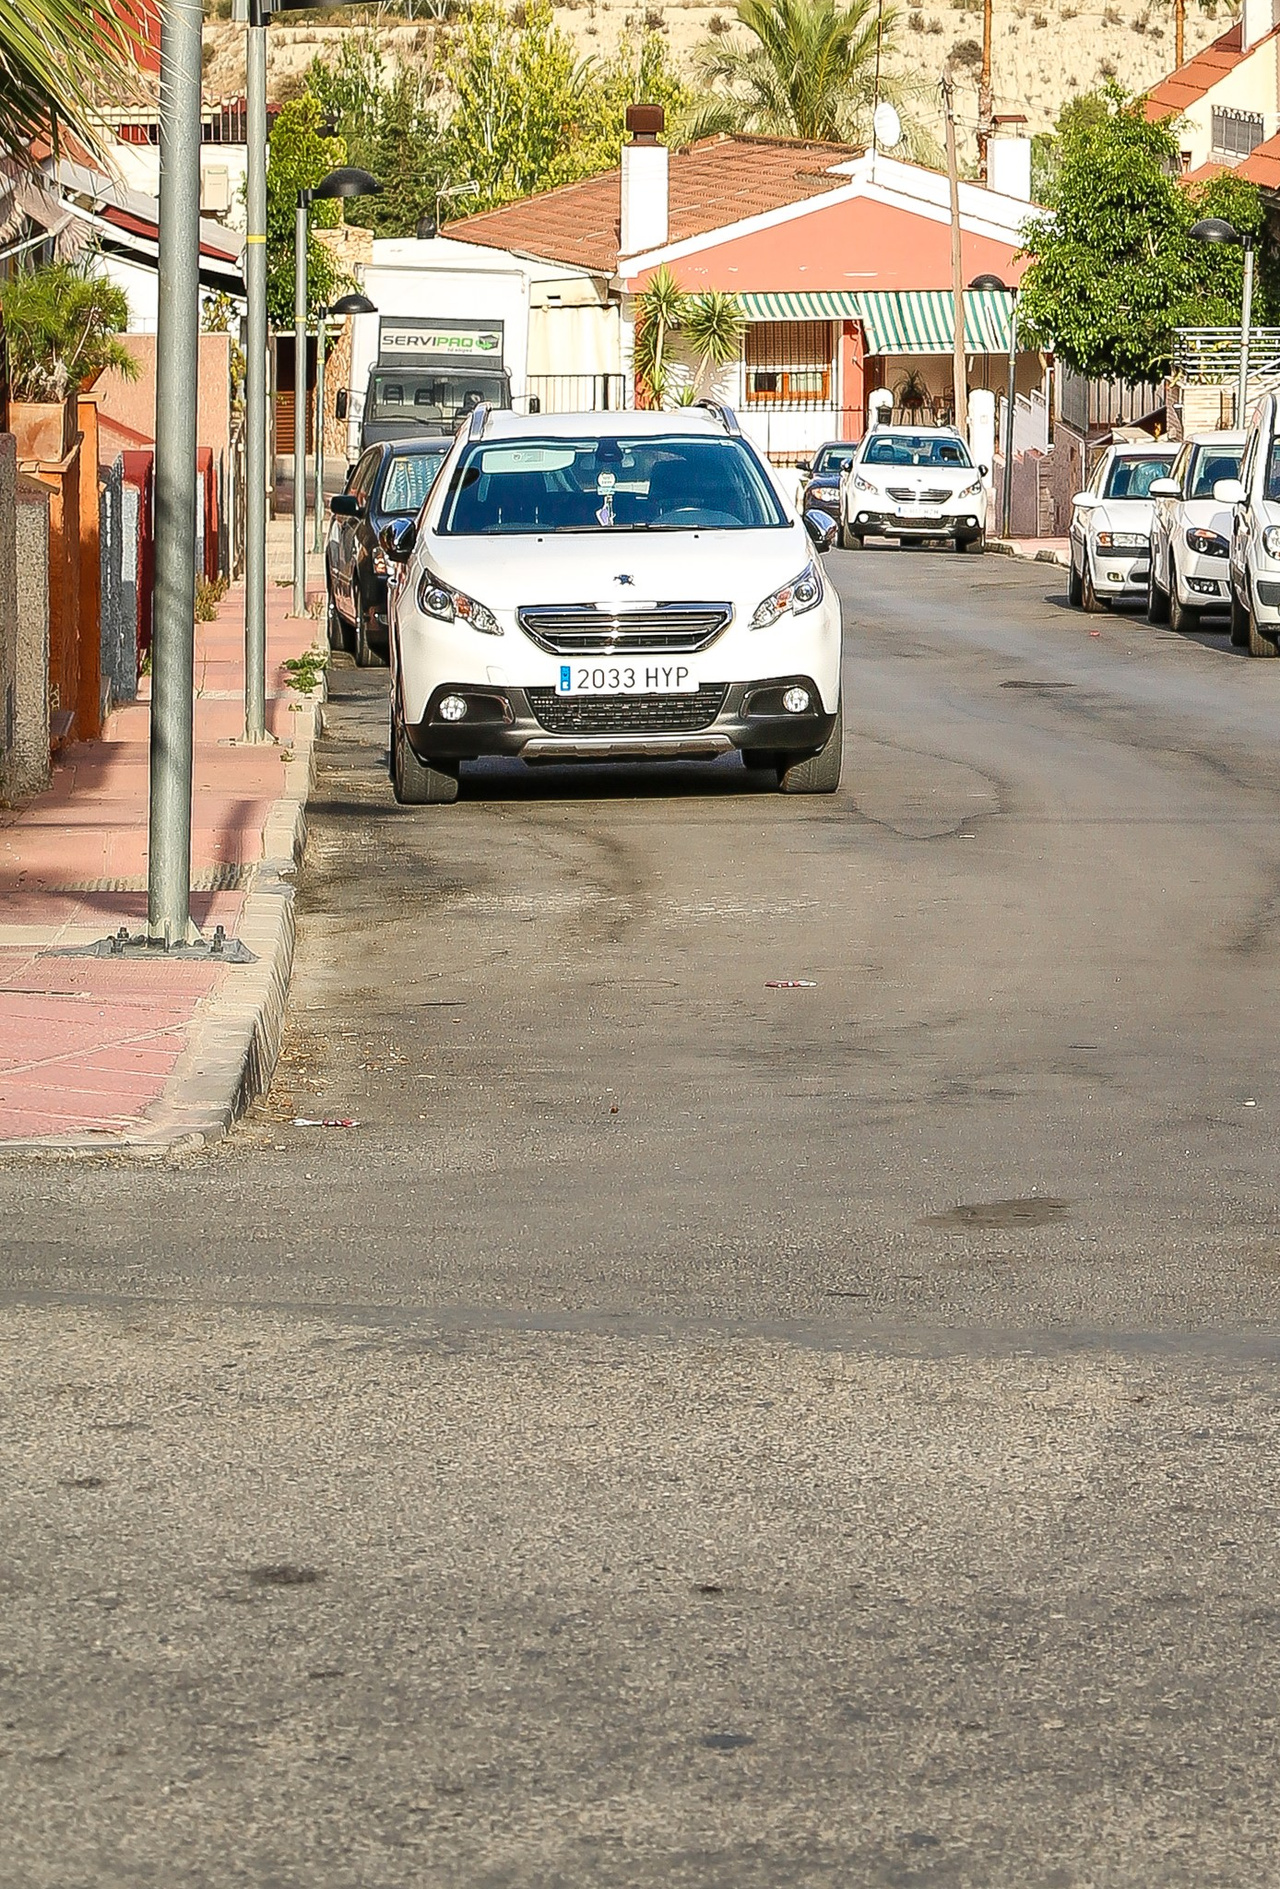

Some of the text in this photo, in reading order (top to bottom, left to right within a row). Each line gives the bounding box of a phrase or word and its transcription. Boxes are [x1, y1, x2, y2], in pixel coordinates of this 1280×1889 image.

[382, 335, 473, 348] SERVIPAQ
[577, 668, 636, 689] 2033
[645, 666, 689, 688] HYP
